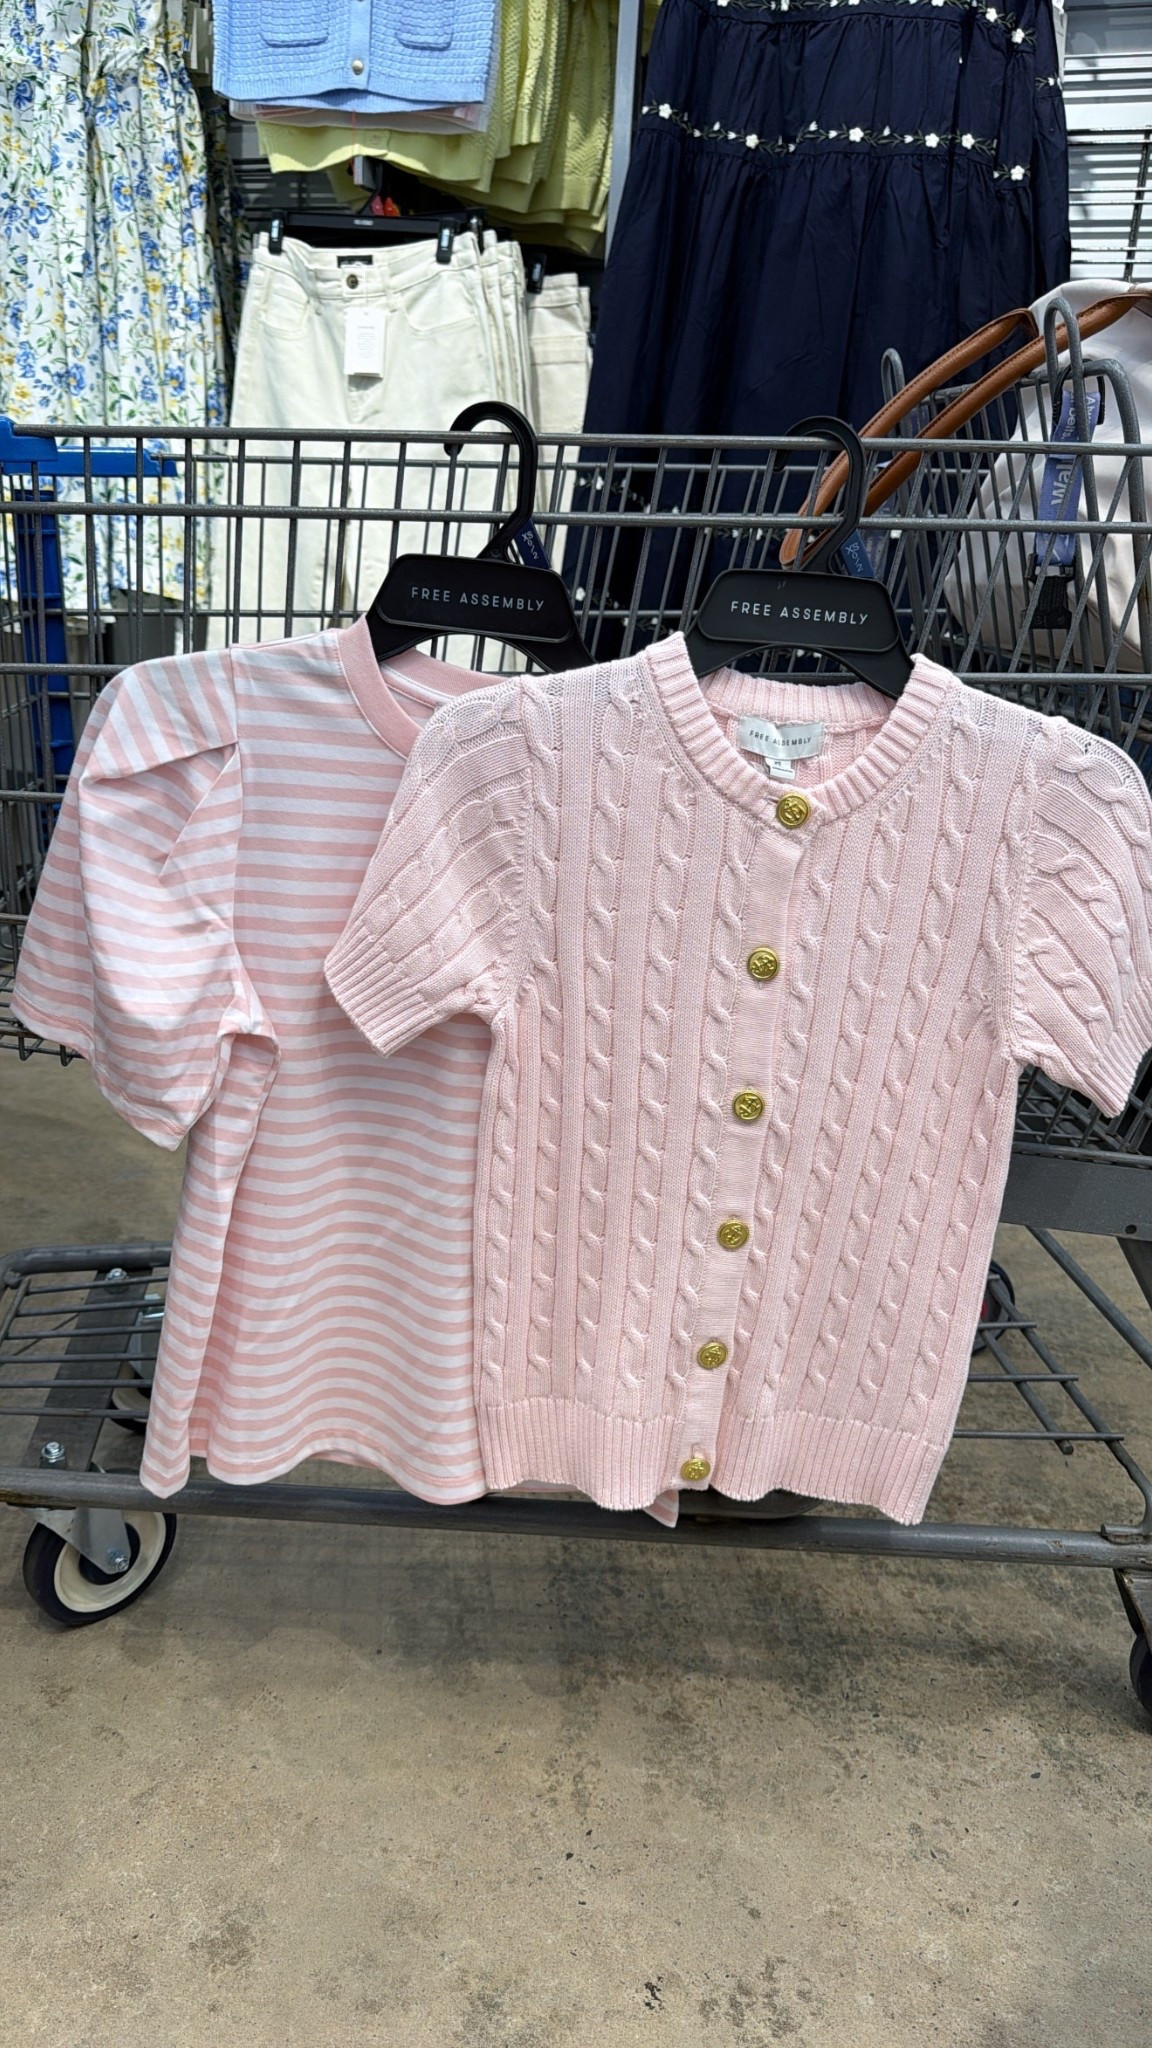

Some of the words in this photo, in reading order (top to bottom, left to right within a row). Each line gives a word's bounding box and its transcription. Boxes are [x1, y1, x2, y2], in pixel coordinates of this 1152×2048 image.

[521, 531, 534, 541] XS
[411, 587, 451, 602] FREE
[459, 592, 544, 611] ASSEMBLY
[731, 601, 772, 617] FREE
[780, 606, 868, 625] ASSEMBLY
[749, 730, 769, 742] FREE
